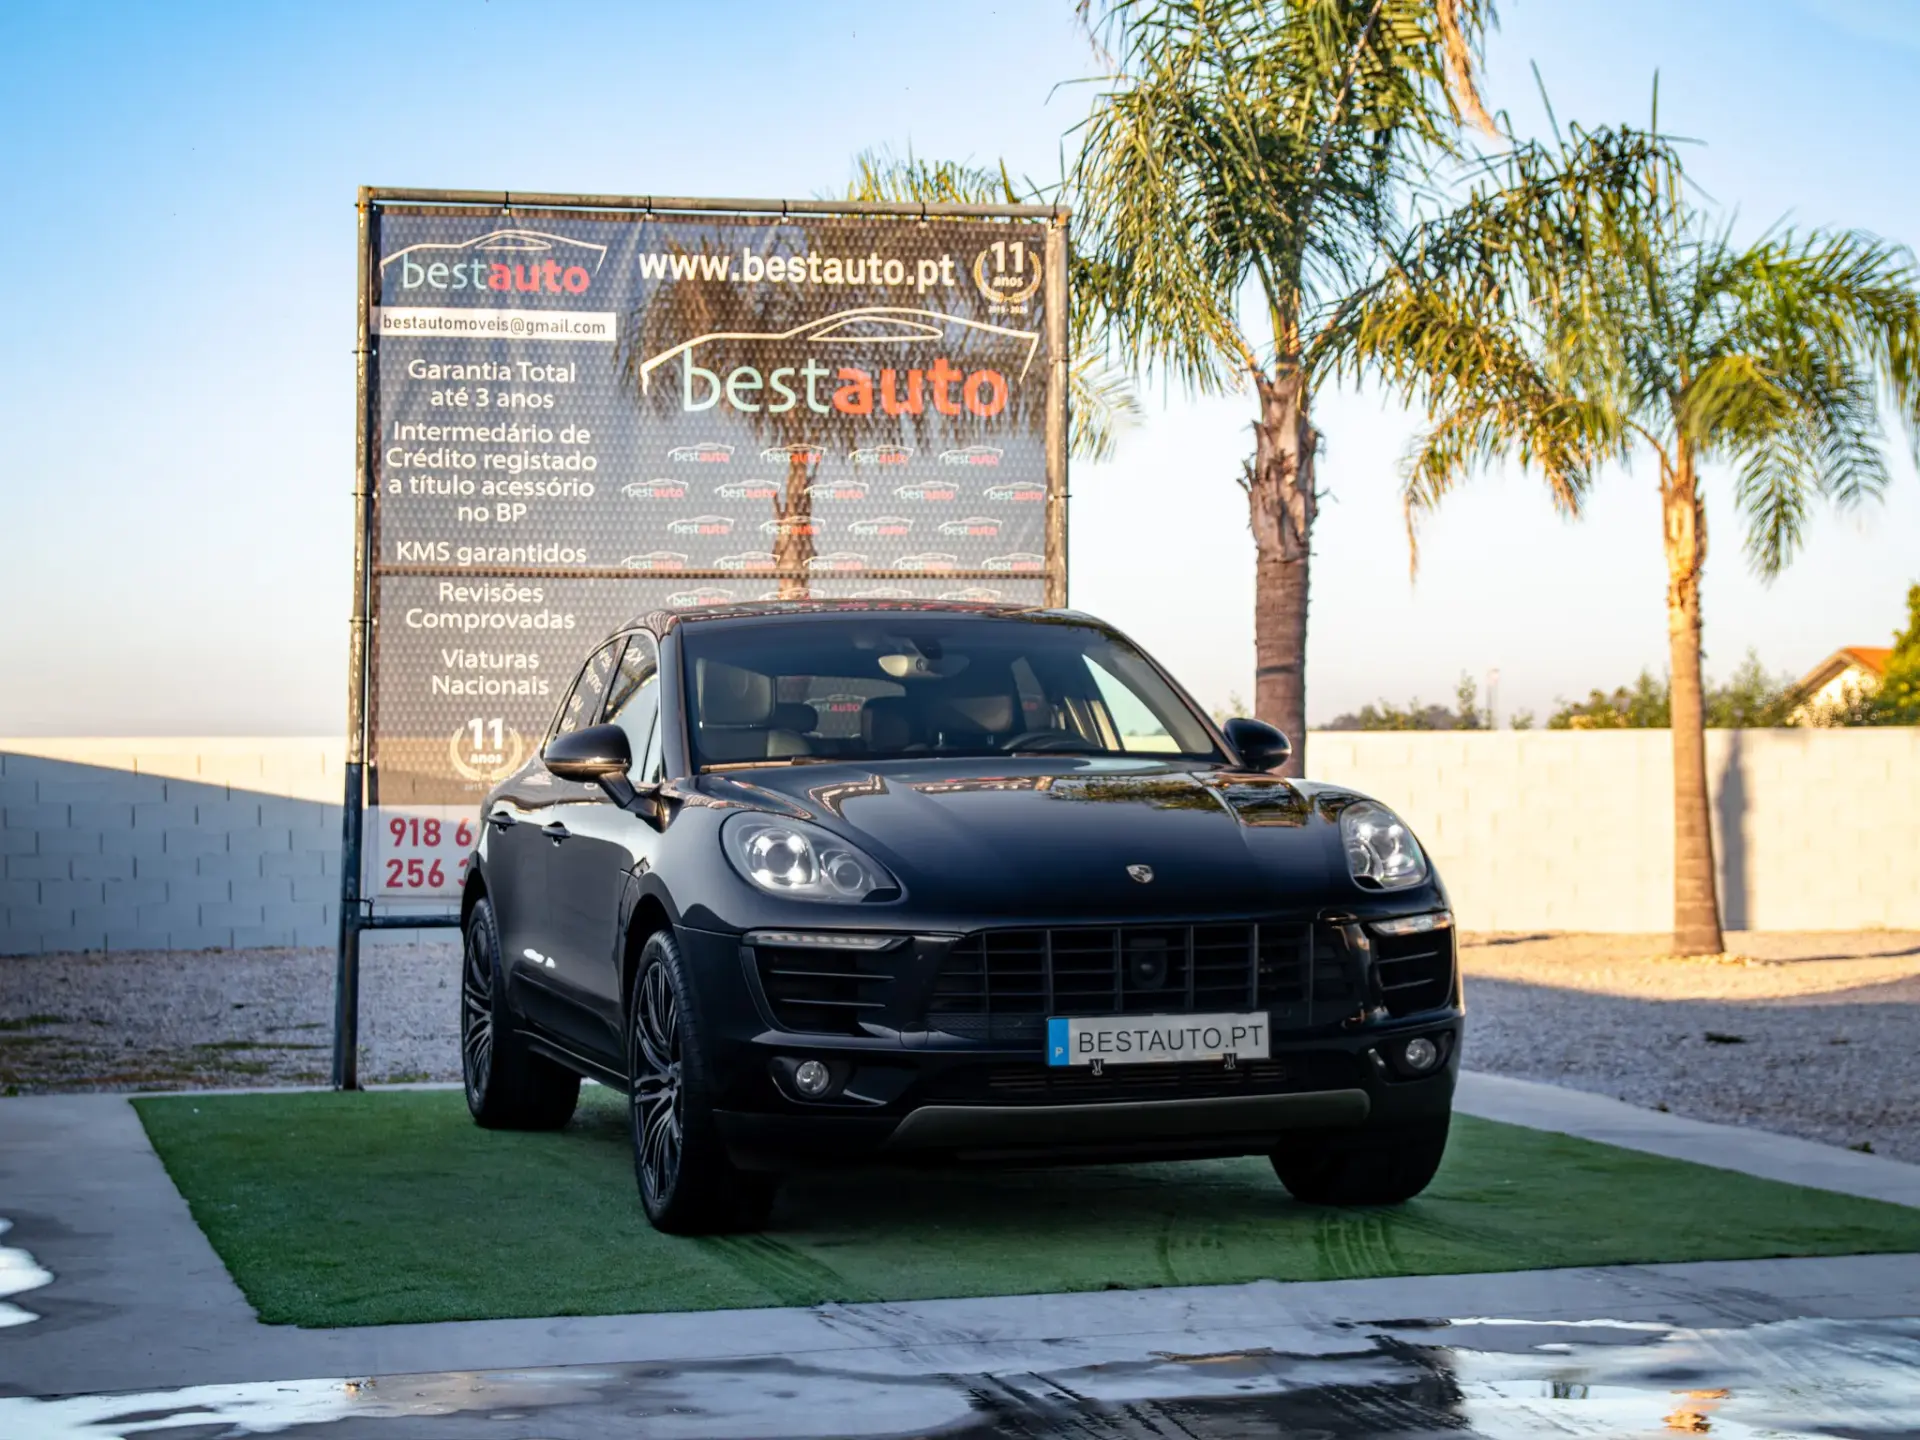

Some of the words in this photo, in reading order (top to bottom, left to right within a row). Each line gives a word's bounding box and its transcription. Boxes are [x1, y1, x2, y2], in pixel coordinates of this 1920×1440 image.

[991, 241, 1023, 273] 11
[402, 252, 590, 293] bestauto
[639, 248, 955, 294] www.bestauto.pt
[993, 276, 1023, 288] anos
[383, 314, 606, 335] bestautomoveis@gmail.com
[408, 359, 512, 381] Garantia
[517, 362, 576, 384] Total
[683, 348, 1008, 416] bestauto
[430, 388, 469, 408] até
[476, 388, 490, 407] 3
[497, 392, 554, 409] anos
[394, 421, 554, 444] Intermedário
[560, 424, 591, 445] de
[386, 448, 477, 469] Crédito
[484, 451, 598, 474] registado
[388, 478, 402, 494] a
[410, 475, 475, 495] título
[481, 478, 595, 497] acessório
[458, 507, 489, 521] no
[496, 503, 527, 522] BP
[397, 541, 450, 561] KMS
[457, 543, 587, 566] garantidos
[439, 582, 543, 602] Revisões
[406, 608, 575, 632] Comprovadas
[442, 650, 539, 668] Viaturas
[432, 676, 549, 695] Nacionais
[468, 718, 504, 749] 11
[470, 752, 502, 764] anos
[390, 818, 441, 847] 918
[386, 859, 445, 888] 256
[1079, 1025, 1263, 1053] BESTAUTO.PT
[1055, 1047, 1063, 1057] P
